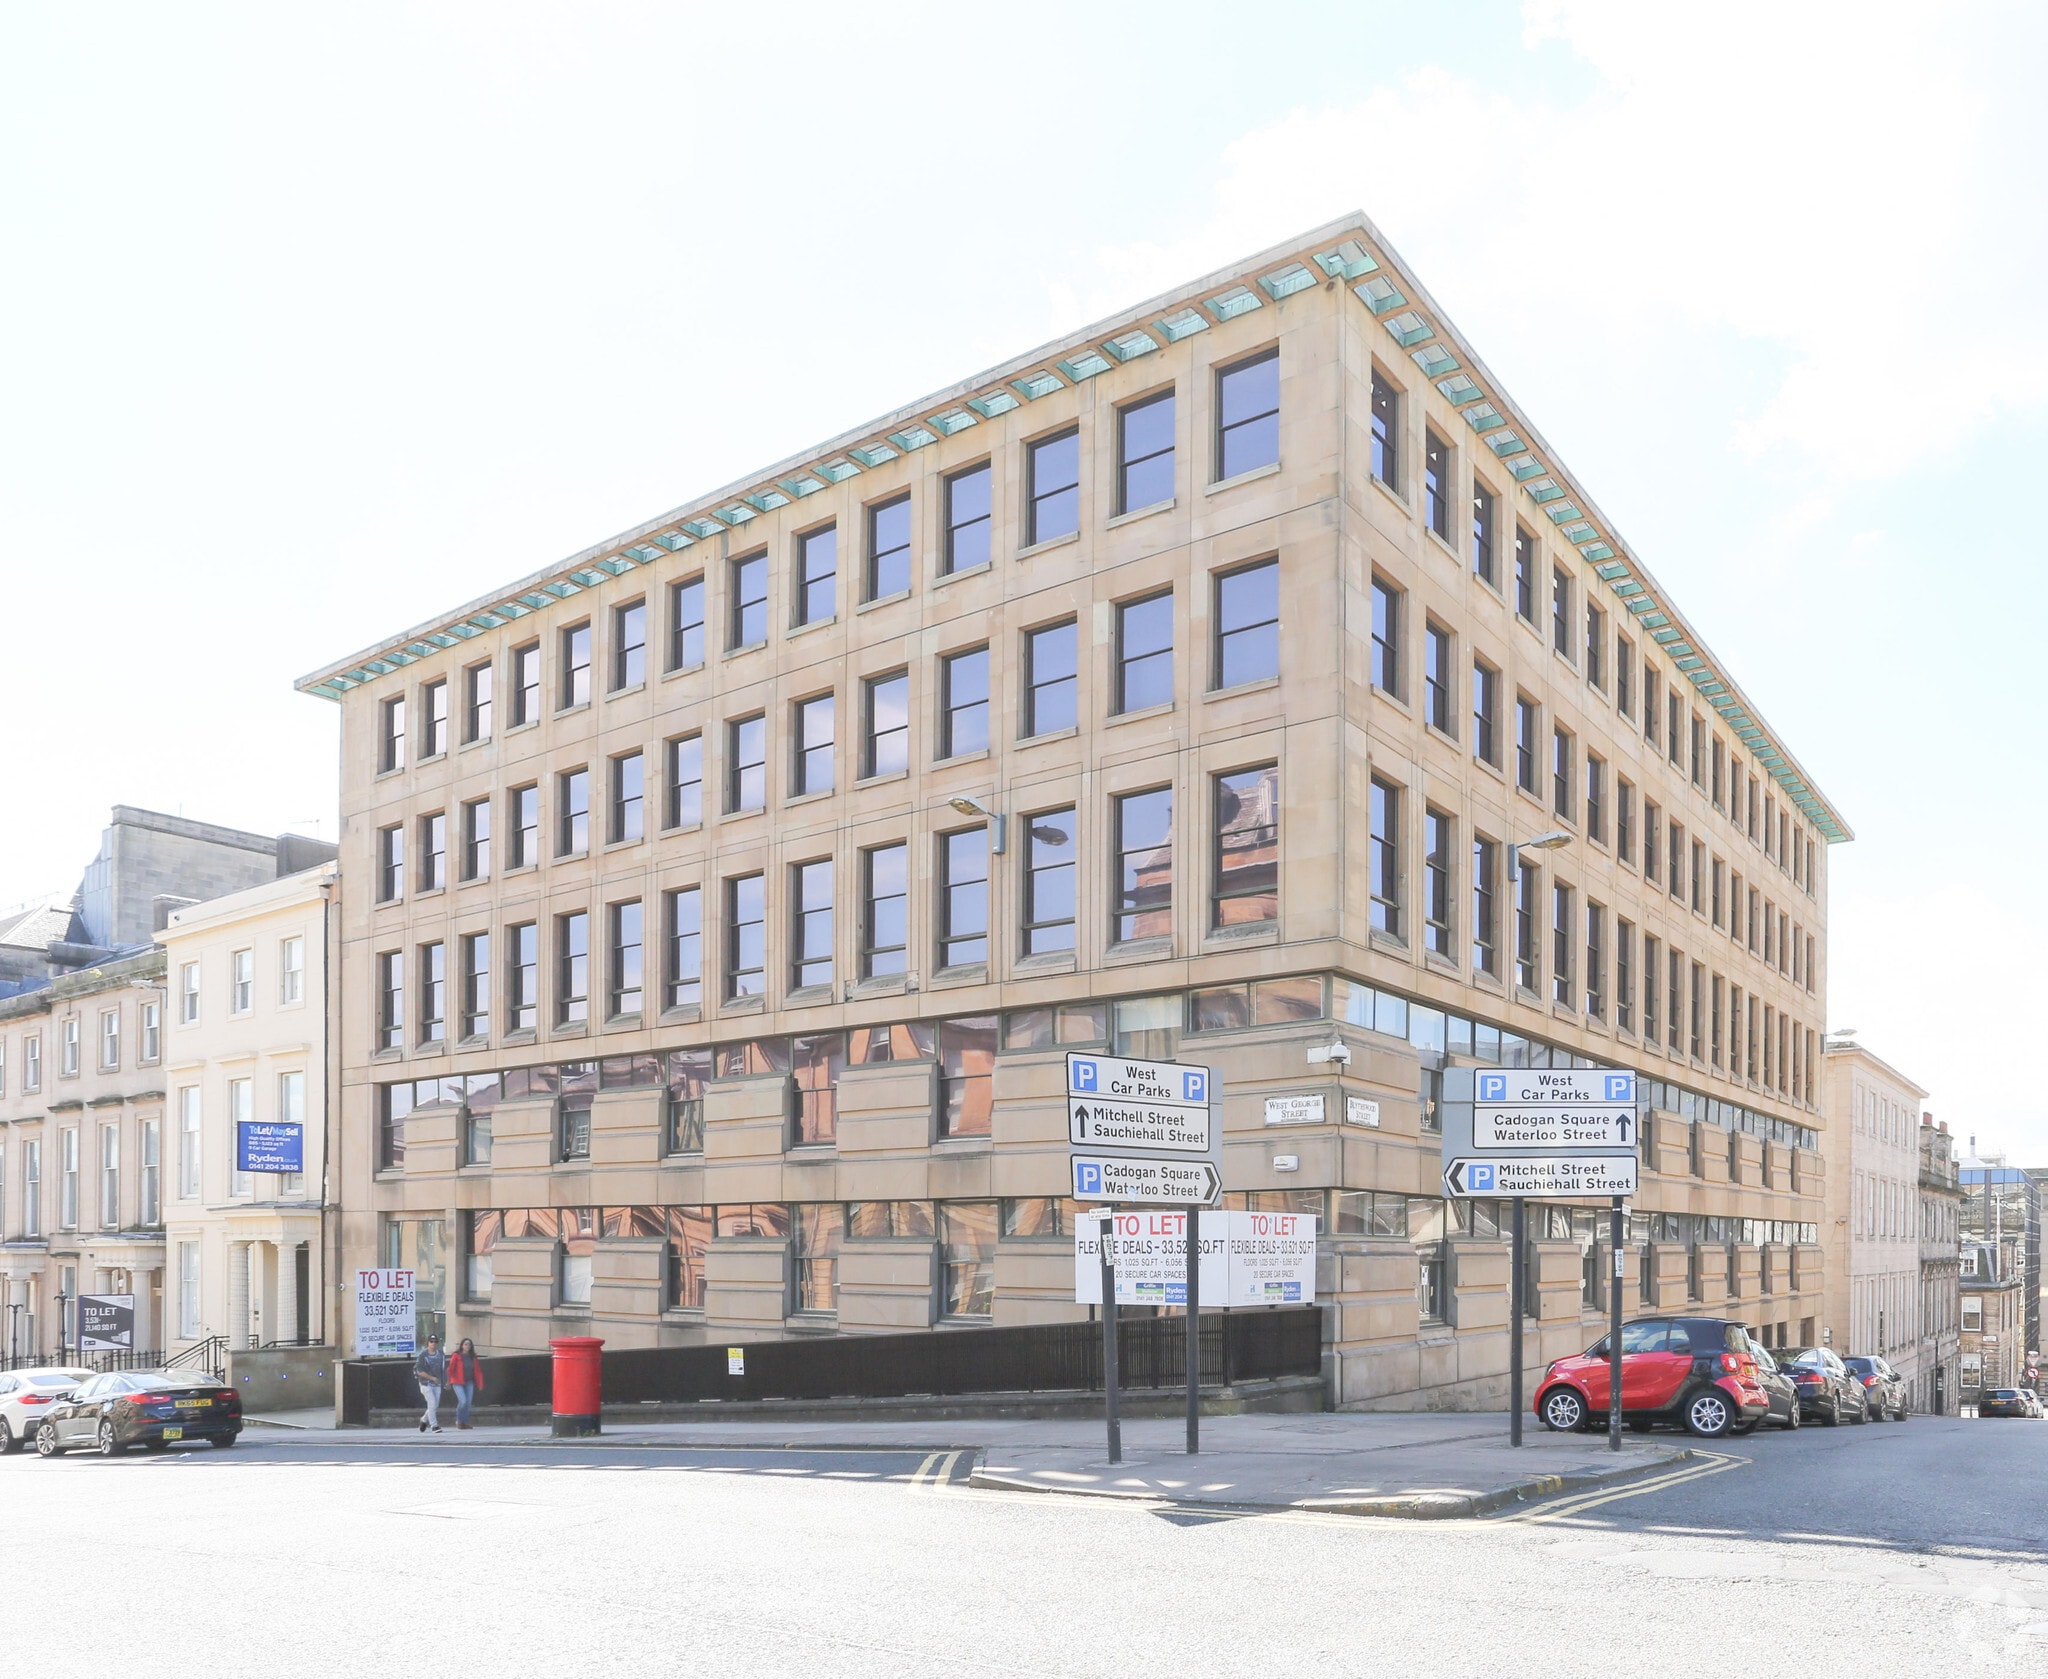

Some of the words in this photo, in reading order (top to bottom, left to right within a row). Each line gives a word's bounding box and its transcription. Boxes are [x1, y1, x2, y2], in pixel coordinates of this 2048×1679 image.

[1078, 1064, 1094, 1088] P
[1126, 1066, 1156, 1080] West
[1538, 1075, 1573, 1086] West
[1111, 1080, 1132, 1094] Car
[1138, 1084, 1171, 1098] Parks
[1188, 1076, 1202, 1098] P
[1486, 1078, 1503, 1099] P
[1521, 1089, 1545, 1100] Car
[1551, 1089, 1590, 1100] Parks
[1610, 1078, 1628, 1099] P
[1094, 1108, 1144, 1124] Mitchell
[1148, 1112, 1184, 1126] Street
[1494, 1114, 1555, 1128] Cadogan
[1560, 1114, 1610, 1127] Square
[1094, 1124, 1164, 1141] Sauchiehall
[1168, 1130, 1204, 1144] Street
[1494, 1130, 1557, 1140] Waterloo
[1562, 1128, 1608, 1140] Street
[1082, 1166, 1098, 1190] P
[1104, 1164, 1156, 1180] Cadogan
[1160, 1167, 1200, 1181] Square
[1474, 1167, 1491, 1188] P
[1499, 1164, 1555, 1176] Mitchell
[1561, 1164, 1606, 1175] Street
[1163, 1184, 1198, 1196] Street
[1499, 1179, 1580, 1190] Sauchiehall
[1586, 1178, 1631, 1189] Street
[1114, 1215, 1140, 1236] TO
[1150, 1215, 1186, 1236] LET
[1250, 1215, 1268, 1236] TO
[1274, 1216, 1297, 1236] LET
[1079, 1240, 1119, 1254] FLEXE
[1123, 1240, 1152, 1254] DEALS
[1162, 1240, 1188, 1256] 33,52
[1231, 1240, 1256, 1254] FLEXIBLE
[1258, 1240, 1276, 1254] DEALS
[359, 1271, 380, 1289] TO
[387, 1271, 414, 1288] LET
[1115, 1270, 1123, 1279] 20
[1125, 1270, 1148, 1279] SECURE
[1150, 1270, 1161, 1279] CAR
[1164, 1270, 1186, 1279] SPACES
[359, 1292, 390, 1302] FLEXIBLE
[392, 1292, 414, 1302] DEALS
[84, 1307, 97, 1316] TO
[99, 1307, 117, 1316] LET
[364, 1306, 386, 1316] 33,521
[389, 1305, 408, 1315] SQ.FT
